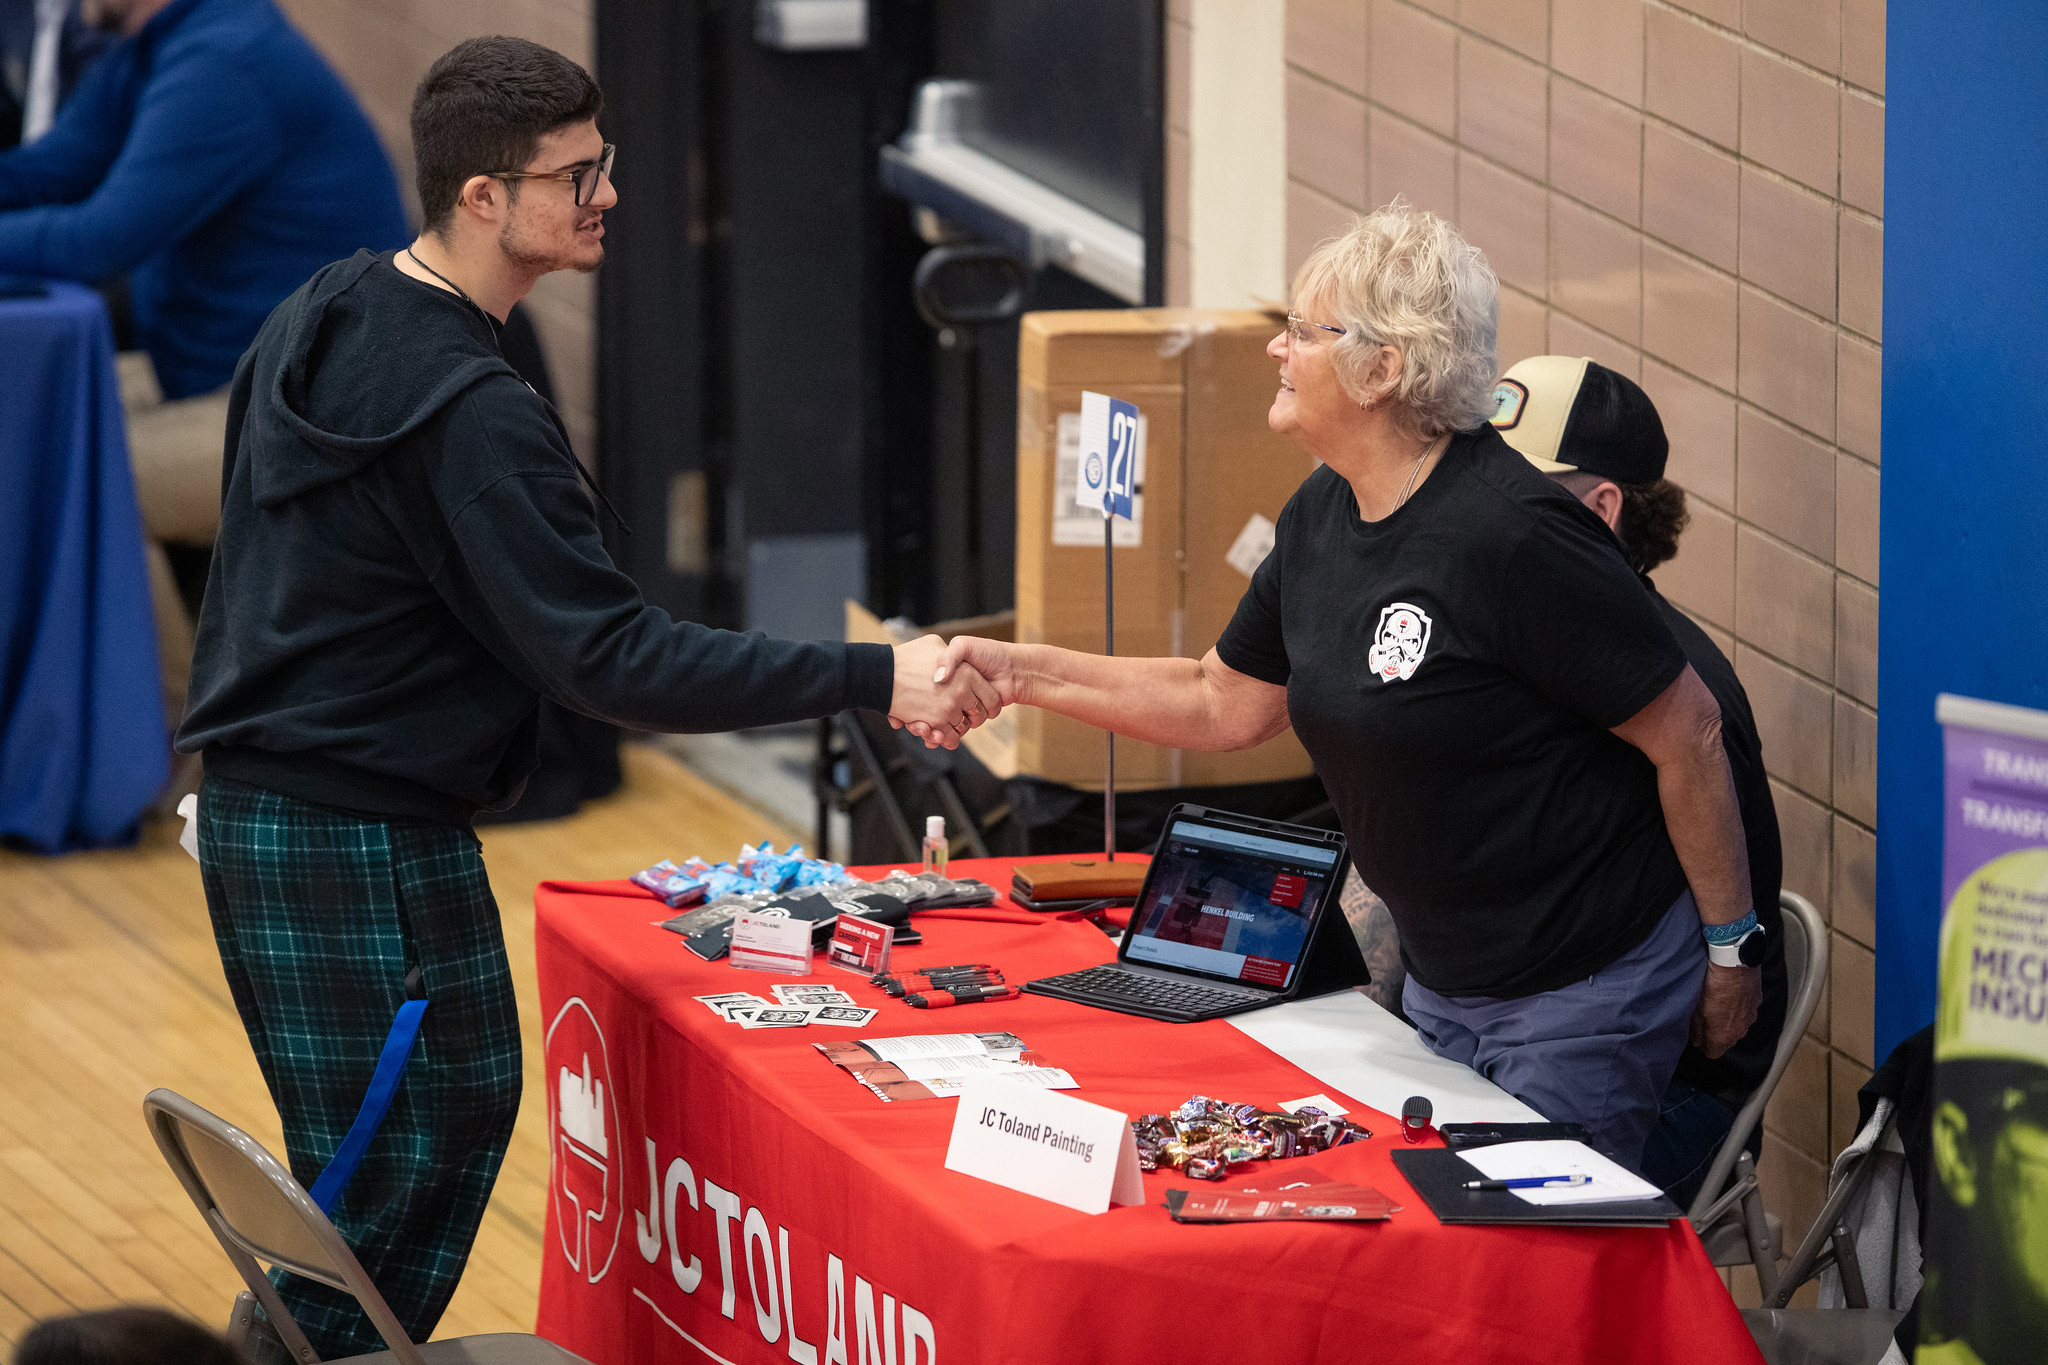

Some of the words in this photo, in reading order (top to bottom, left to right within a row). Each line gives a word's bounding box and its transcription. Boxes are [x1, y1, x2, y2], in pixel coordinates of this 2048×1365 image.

[1112, 412, 1136, 498] 27
[1200, 904, 1225, 917] HENKEL
[1224, 909, 1255, 922] BUILDING
[861, 928, 866, 936] A
[866, 930, 880, 940] NEW
[980, 1107, 996, 1127] JC
[999, 1112, 1041, 1142] Toland
[1042, 1126, 1095, 1163] Painting
